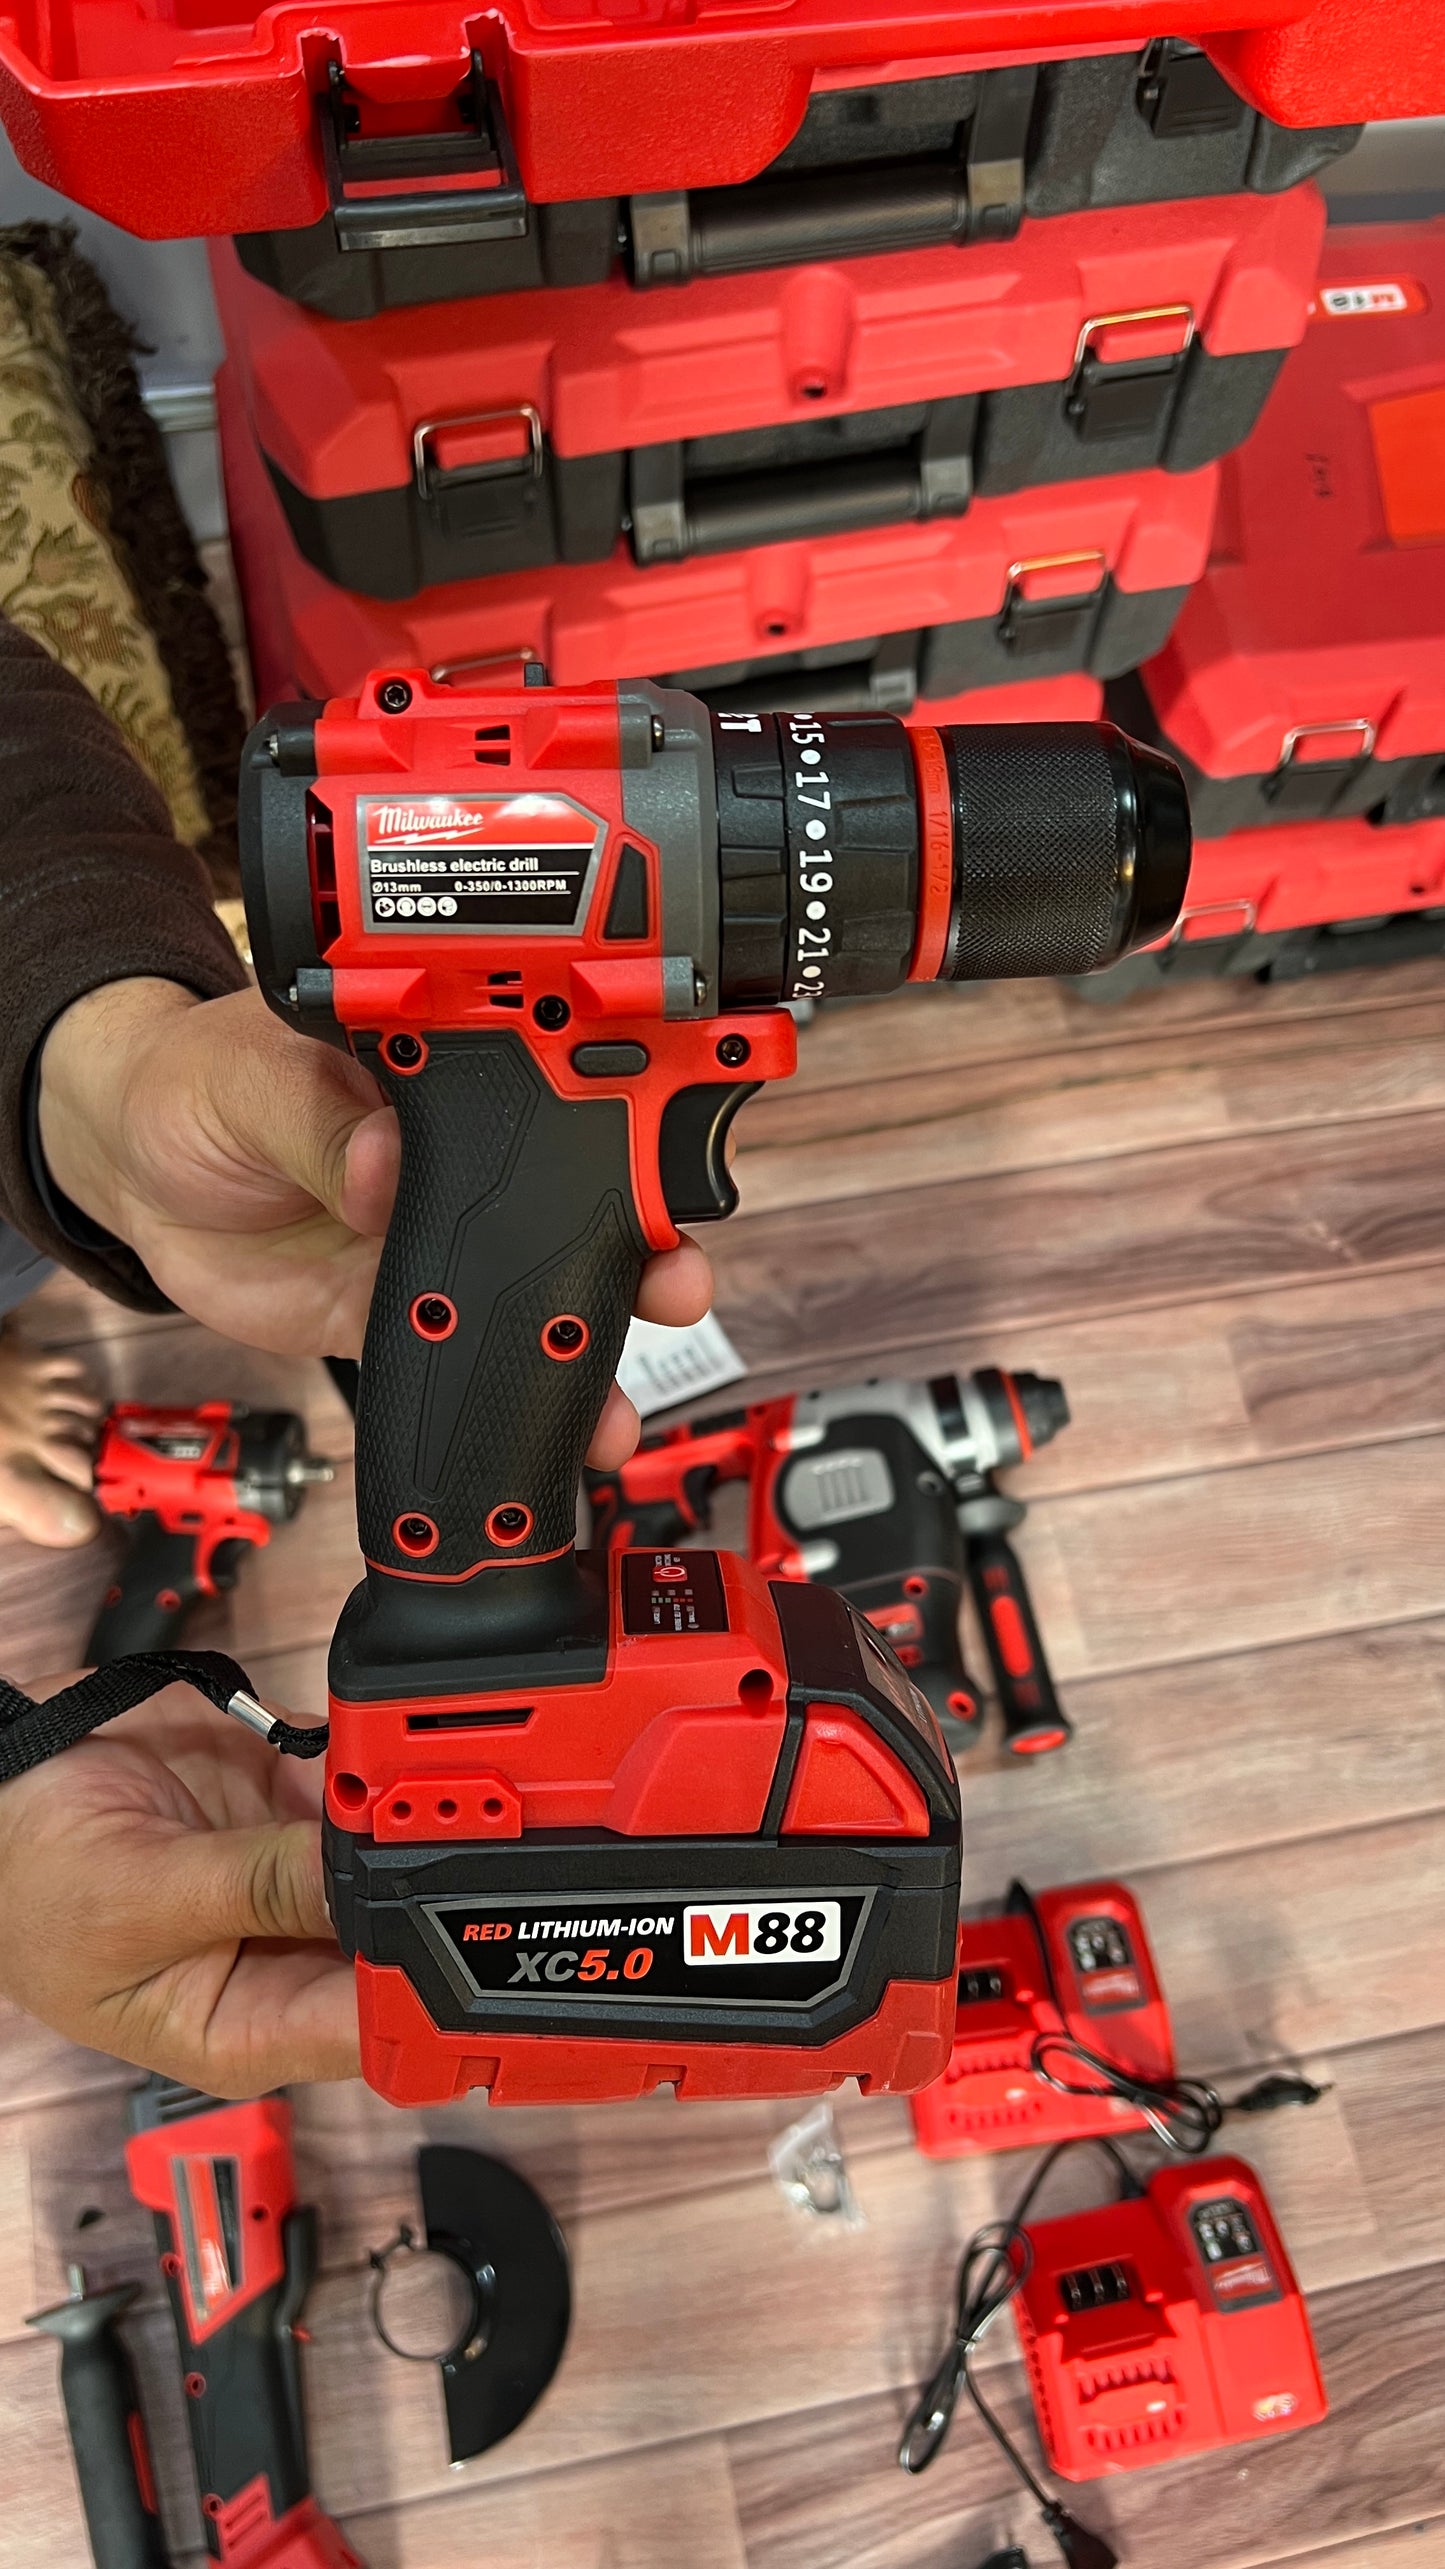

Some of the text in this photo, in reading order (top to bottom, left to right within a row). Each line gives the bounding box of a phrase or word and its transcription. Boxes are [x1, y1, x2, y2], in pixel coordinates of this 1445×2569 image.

[788, 721, 825, 744] 15
[795, 771, 832, 811] 17
[372, 804, 484, 835] Milwaukee
[370, 857, 539, 873] Brushless electric drill
[928, 810, 950, 896] 1/16-1/2
[372, 879, 567, 893] Ø13mm 0-350/0-1300RPM
[799, 849, 833, 894] 19
[797, 927, 832, 962] 21
[462, 1916, 676, 1942] RED LITHIUM-ION
[689, 1910, 827, 1957] M88
[507, 1947, 654, 1984] XC5.0
